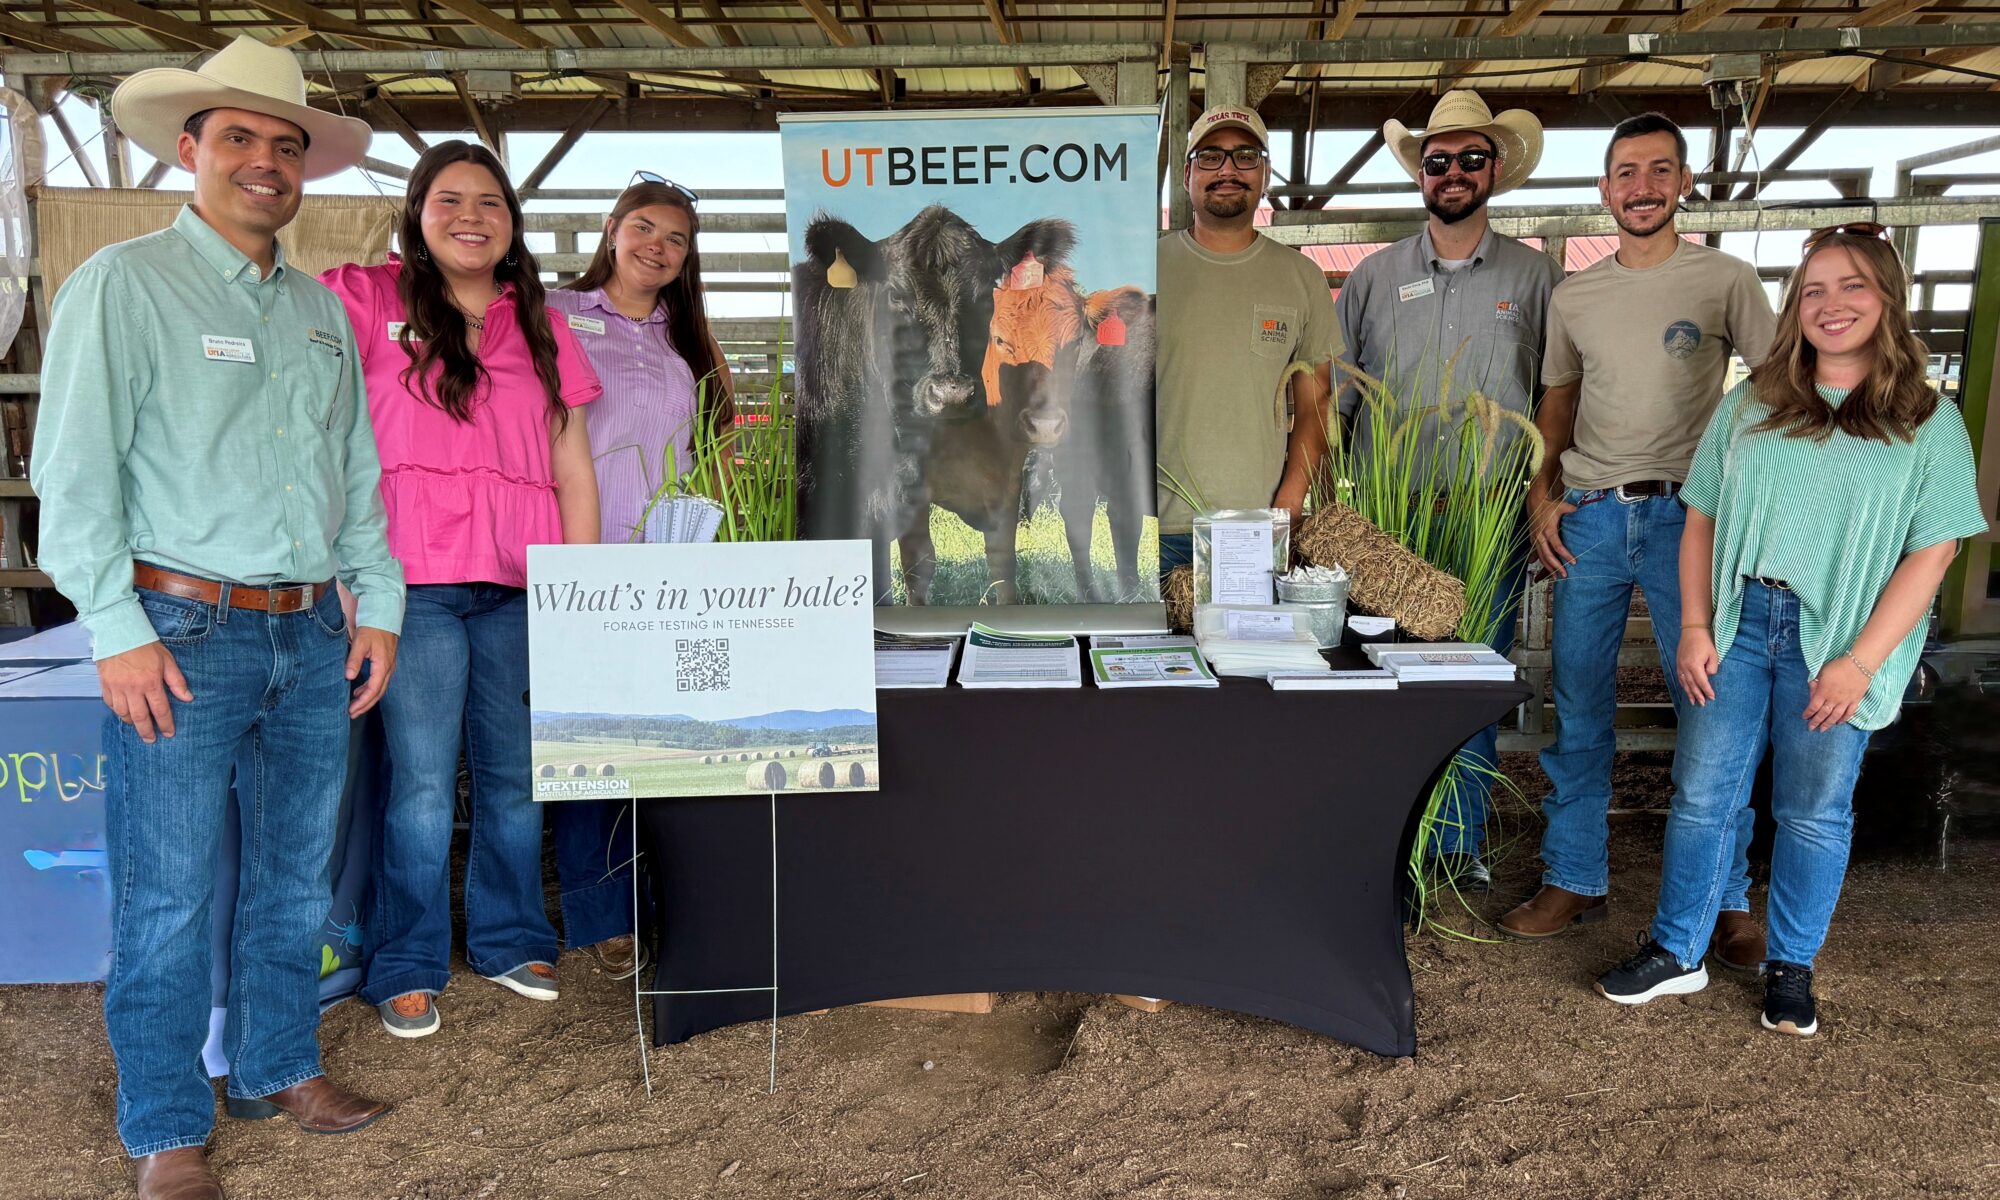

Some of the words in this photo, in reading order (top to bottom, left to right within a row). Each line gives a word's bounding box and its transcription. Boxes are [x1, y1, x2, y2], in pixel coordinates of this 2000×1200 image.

[1207, 112, 1229, 124] TEXAS
[1232, 111, 1250, 123] TECH
[821, 142, 1128, 187] UTBEEF.COM
[1261, 329, 1287, 338] ANIMAL
[532, 580, 645, 613] What's
[656, 580, 688, 611] in
[696, 583, 776, 617] your
[783, 574, 868, 608] bale?
[603, 620, 655, 632] FORAGE
[658, 619, 709, 631] TESTING
[712, 618, 724, 630] IN
[727, 617, 795, 630] TENNESSEE
